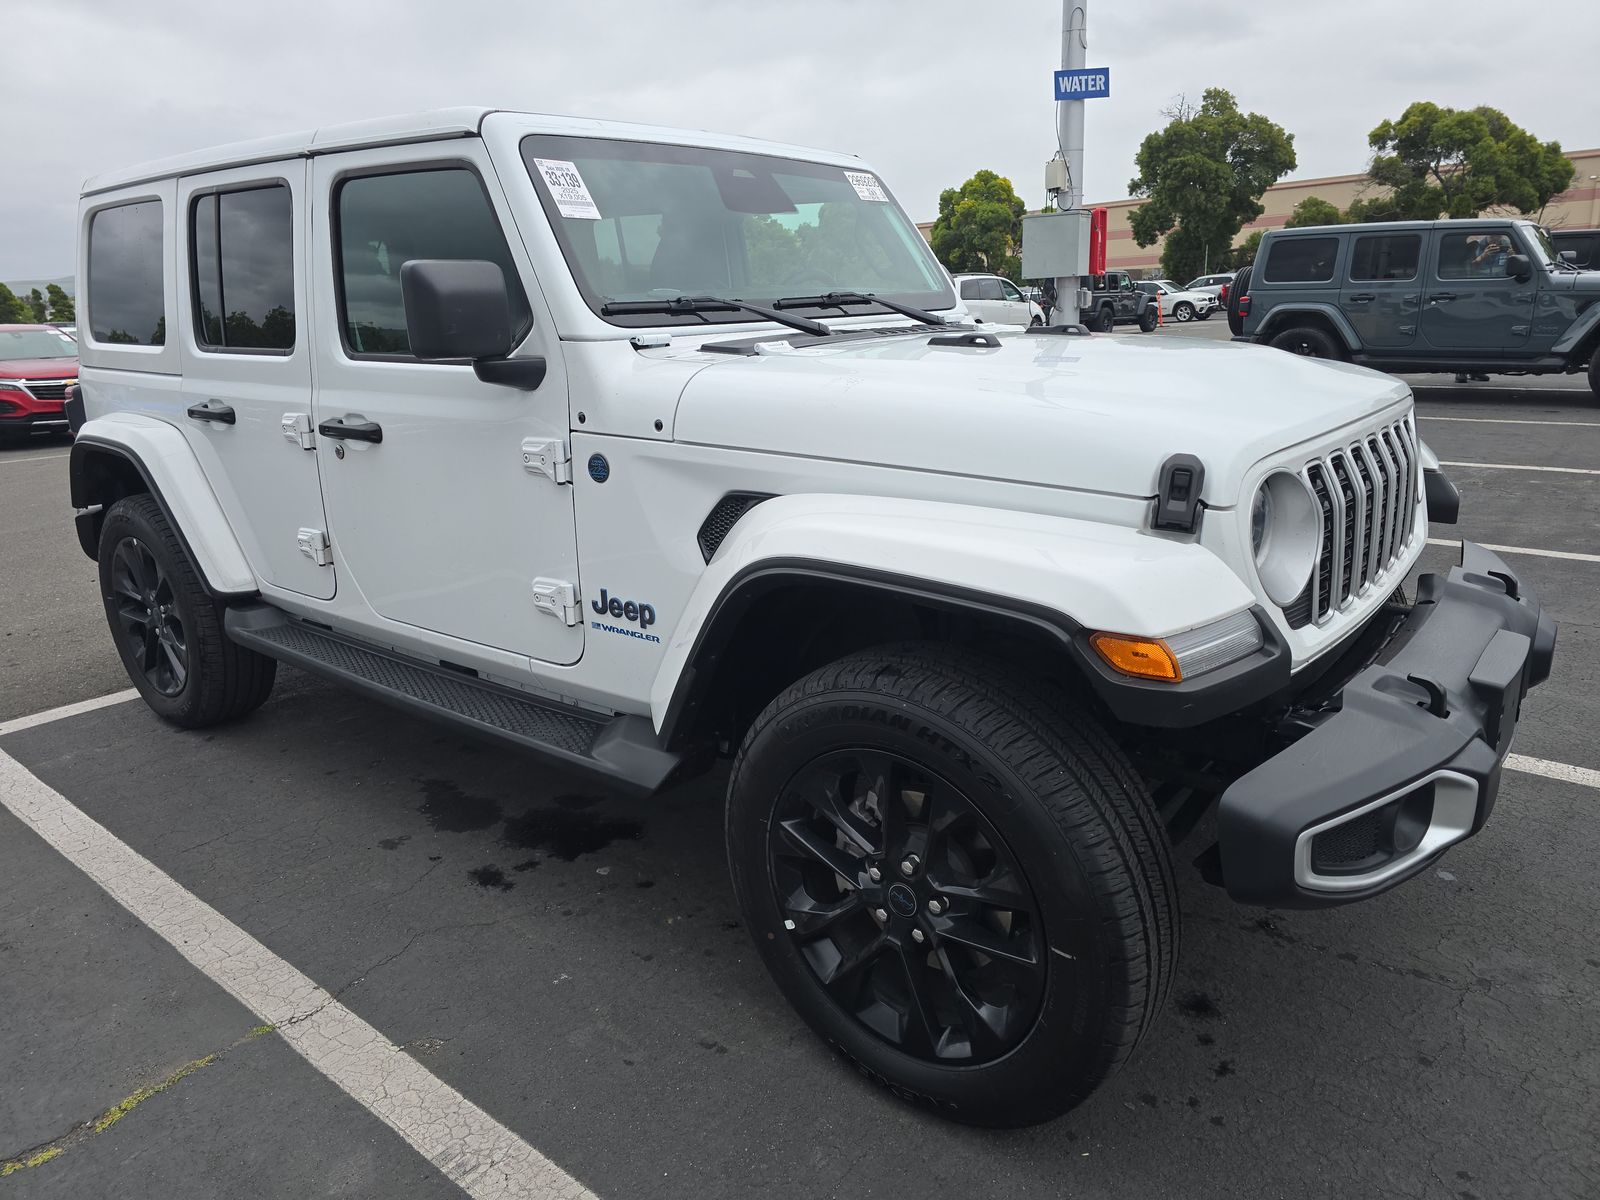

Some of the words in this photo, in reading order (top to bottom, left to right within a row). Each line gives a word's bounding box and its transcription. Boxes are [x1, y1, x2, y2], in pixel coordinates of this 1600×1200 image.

[1058, 74, 1106, 93] WATER
[545, 171, 581, 188] 33:139
[591, 588, 656, 630] Jeep
[601, 623, 661, 644] WRANGLER
[914, 726, 982, 771] HTX
